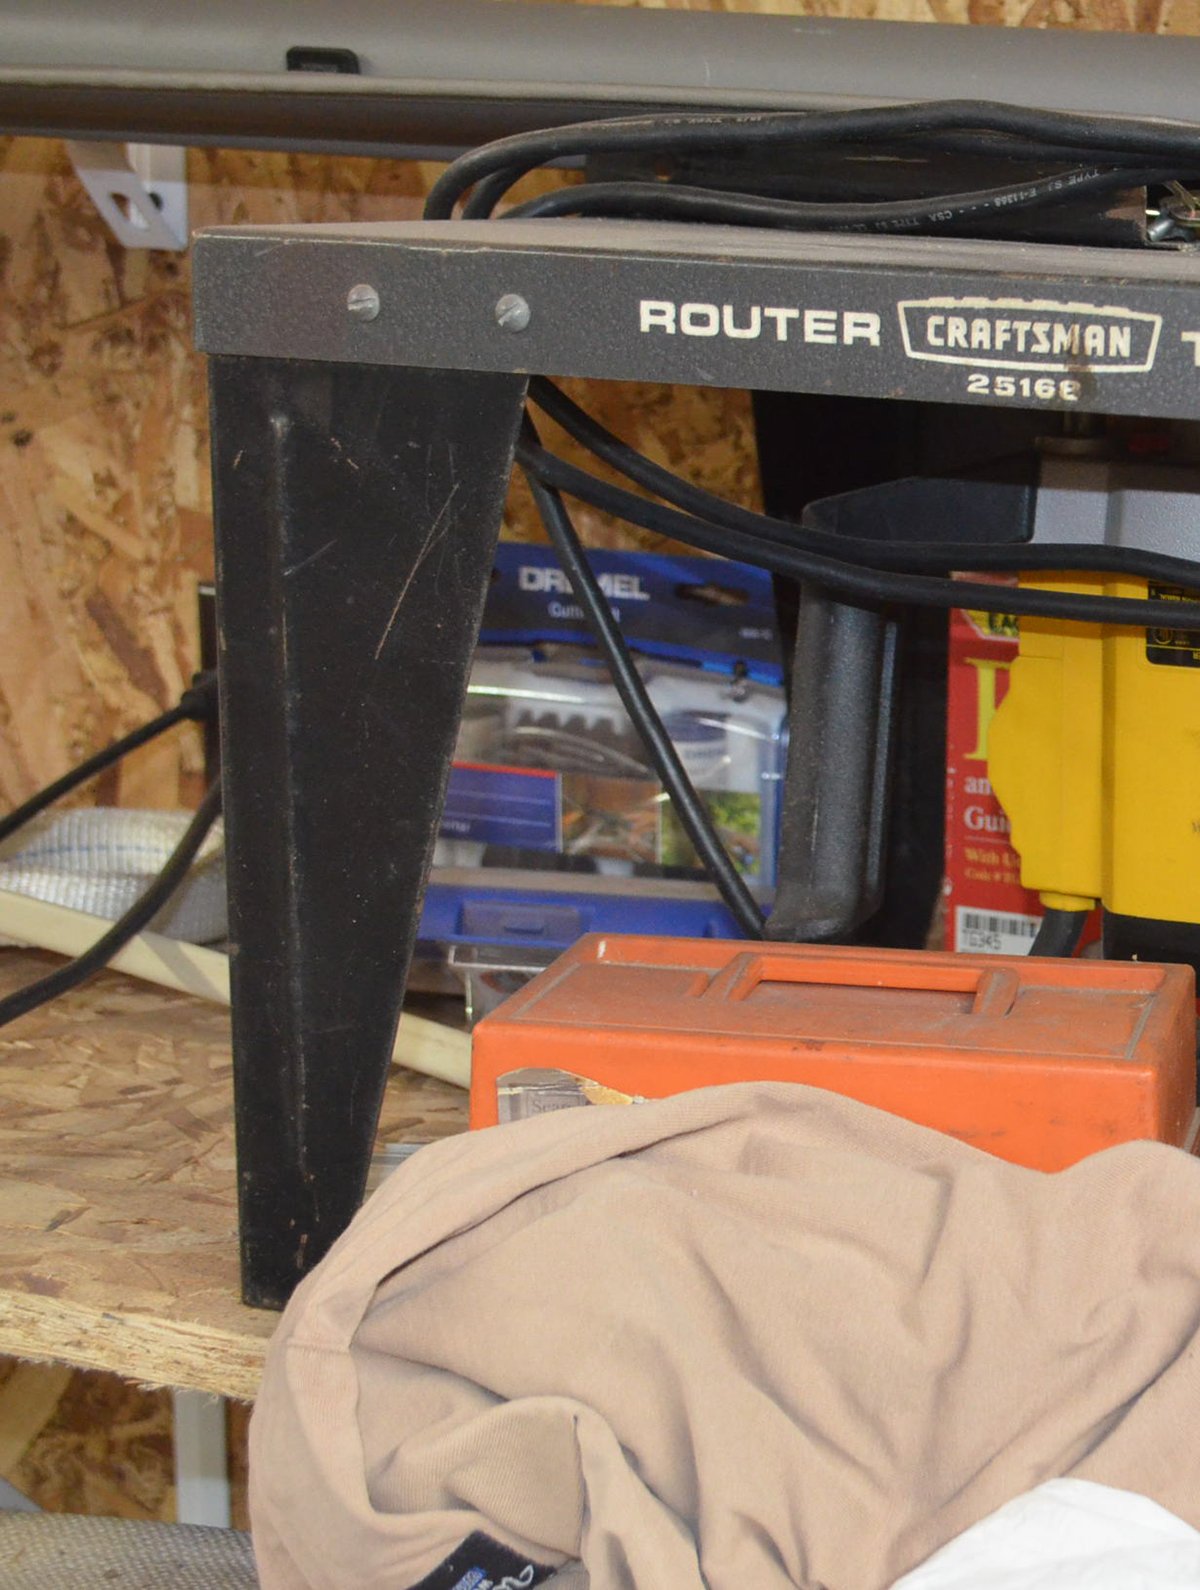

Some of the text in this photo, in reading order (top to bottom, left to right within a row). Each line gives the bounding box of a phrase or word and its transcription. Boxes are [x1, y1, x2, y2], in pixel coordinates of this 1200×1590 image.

[928, 210, 953, 223] CSA
[639, 300, 881, 347] ROUTER
[926, 315, 1132, 358] CRAFTSMAN
[518, 566, 650, 600] DRMEL
[964, 775, 991, 796] an
[964, 805, 1012, 835] Gui
